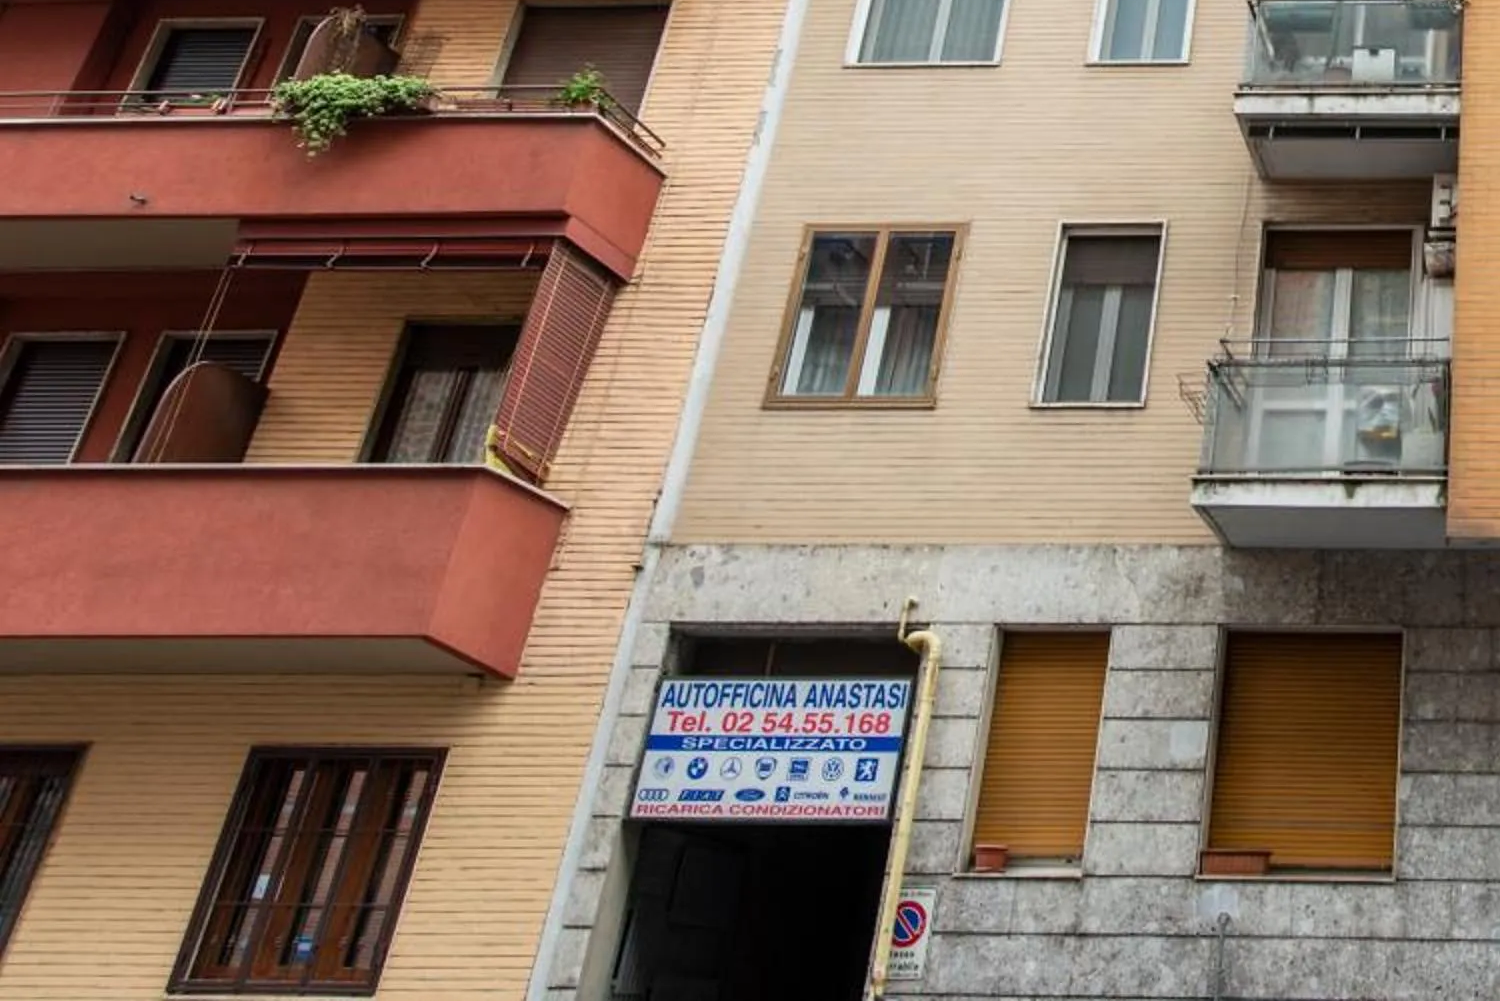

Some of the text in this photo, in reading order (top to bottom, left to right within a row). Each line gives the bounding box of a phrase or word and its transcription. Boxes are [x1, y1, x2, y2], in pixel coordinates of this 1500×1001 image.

[661, 682, 908, 709] AUTOFFICINA ANASTASI
[667, 710, 892, 734] Tel. 02 54.55.168
[680, 736, 868, 750] SPECIALIZZATO
[636, 804, 886, 816] RICARICA CONDIZIONATORI
